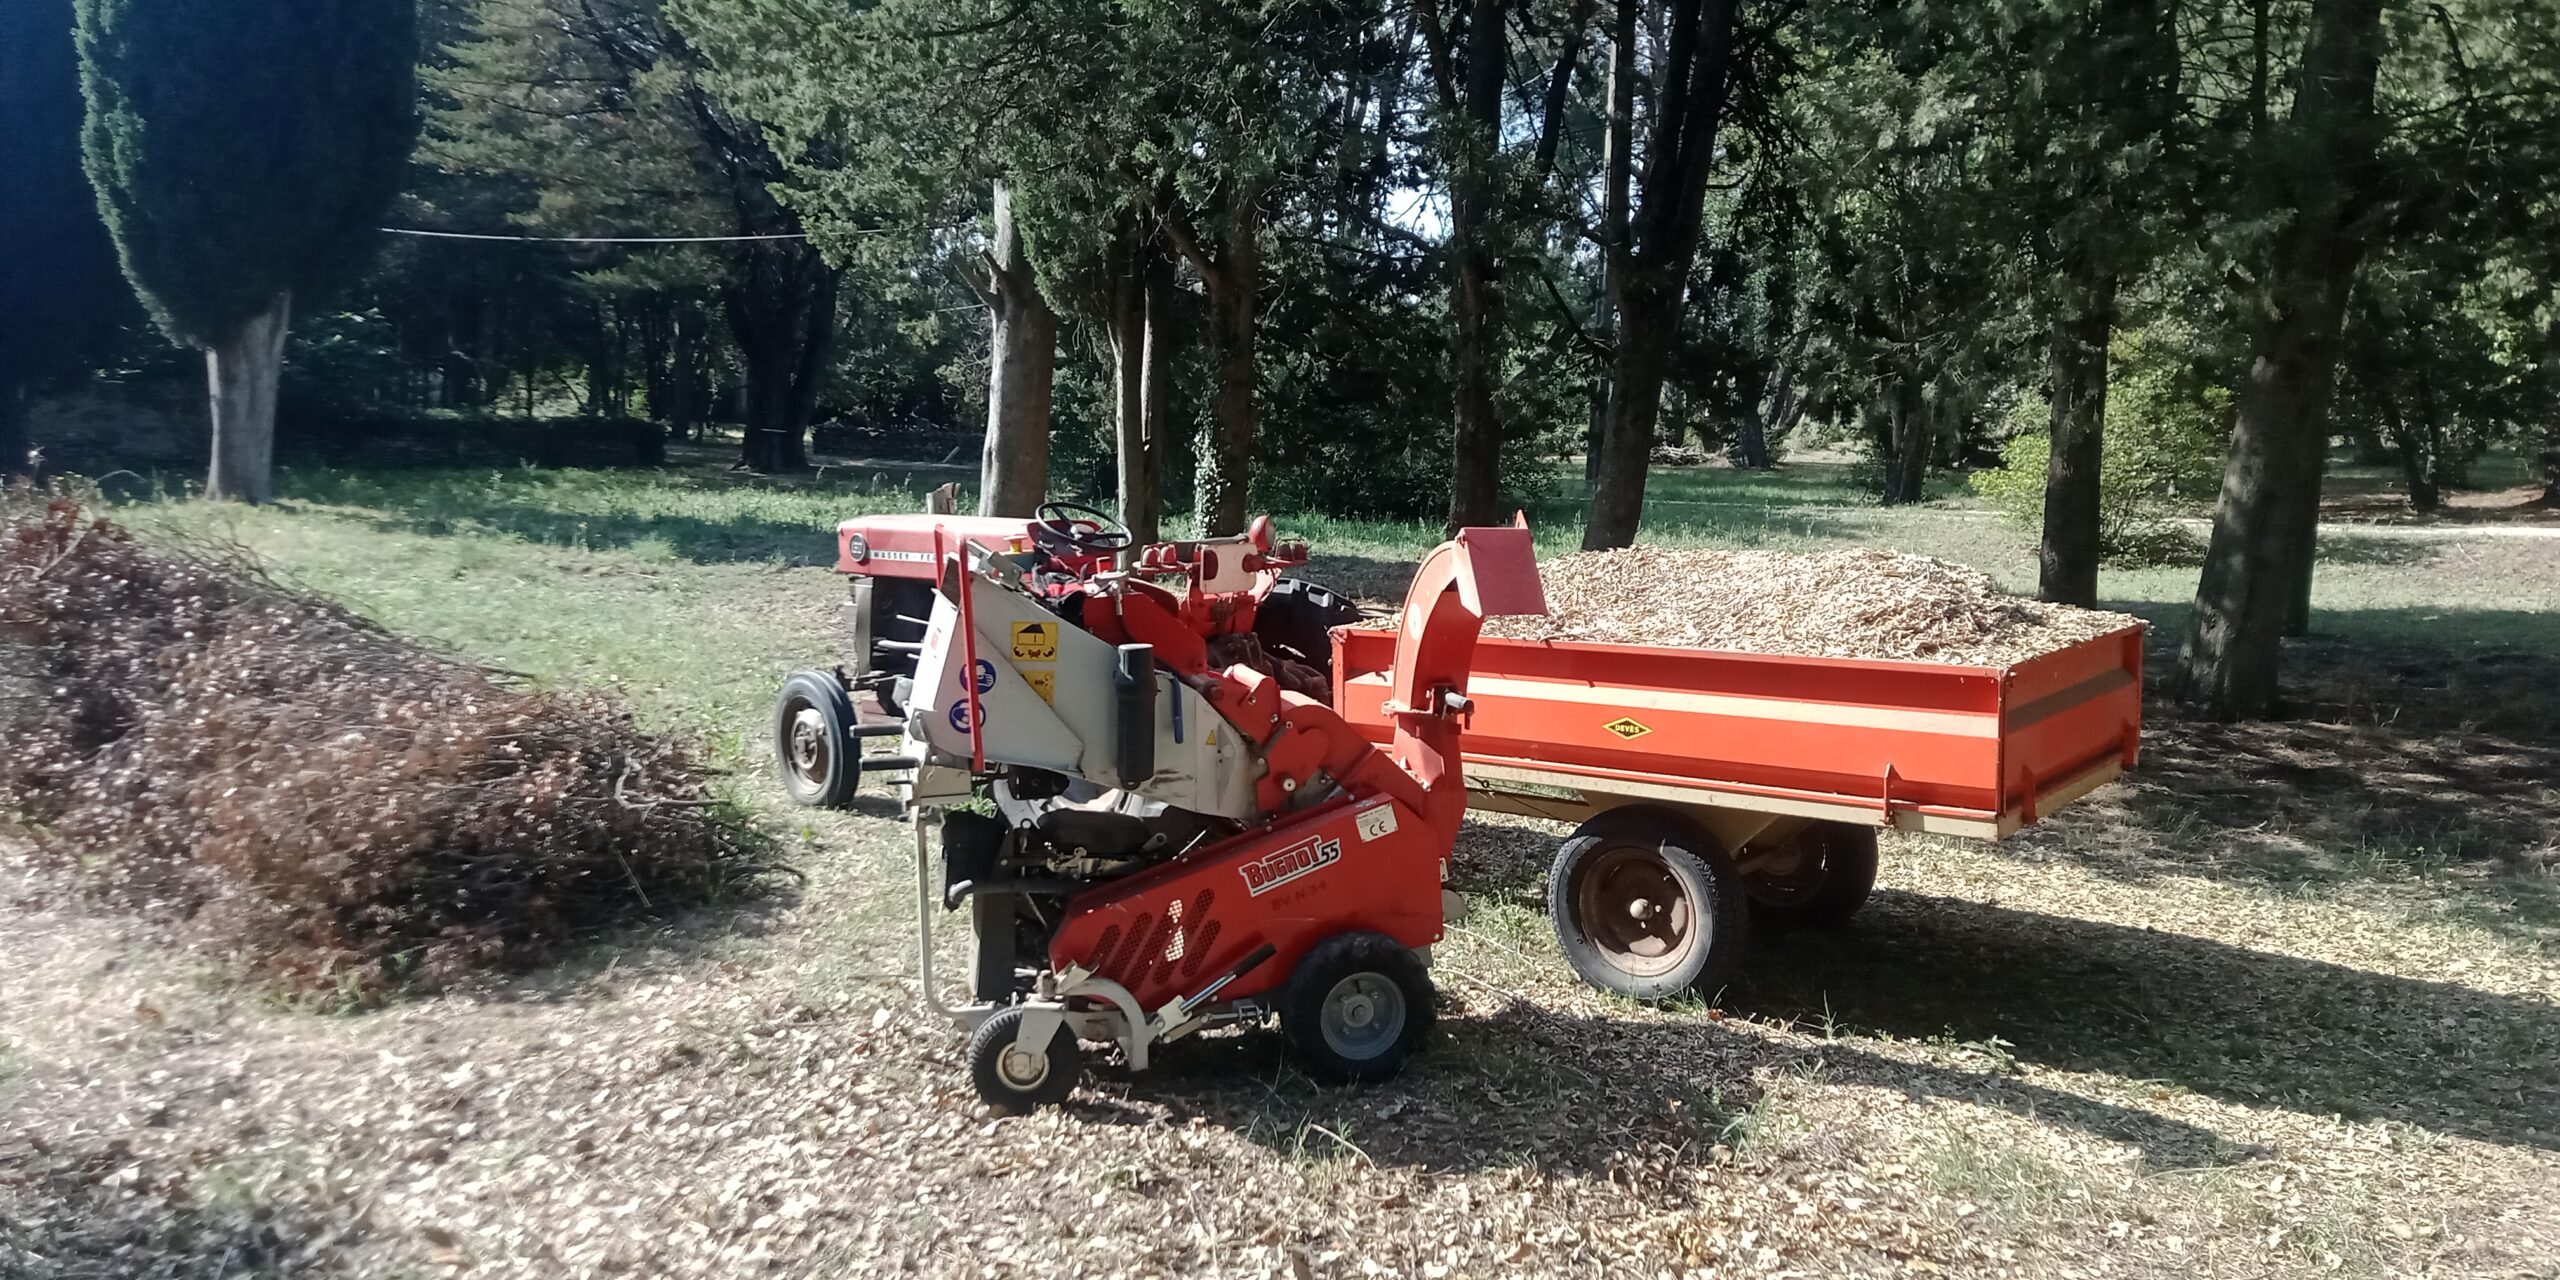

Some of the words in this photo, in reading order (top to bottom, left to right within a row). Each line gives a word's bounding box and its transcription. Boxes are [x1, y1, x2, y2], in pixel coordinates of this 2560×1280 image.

[1369, 820, 1387, 836] CE
[1241, 836, 1320, 889] BUGNOT
[1320, 840, 1340, 862] 55
